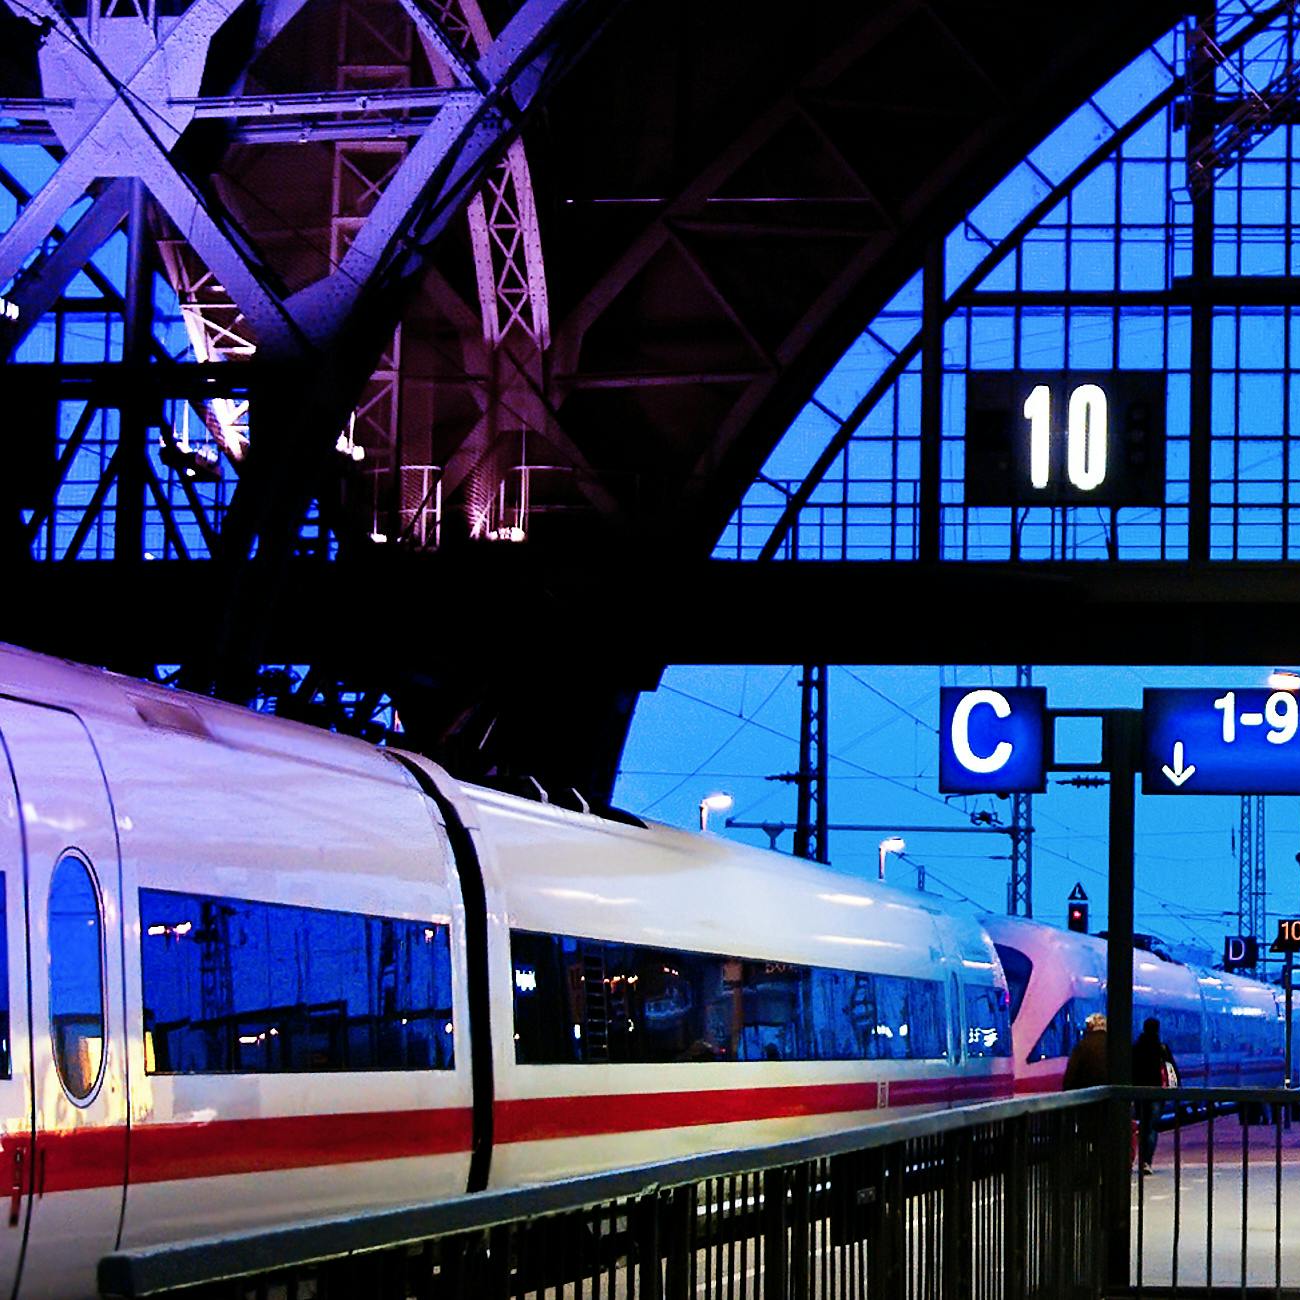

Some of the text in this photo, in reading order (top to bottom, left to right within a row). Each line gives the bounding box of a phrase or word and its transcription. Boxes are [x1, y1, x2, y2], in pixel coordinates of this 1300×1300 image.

[1024, 384, 1107, 490] 10
[951, 689, 1012, 774] C
[1214, 691, 1299, 744] 1-9
